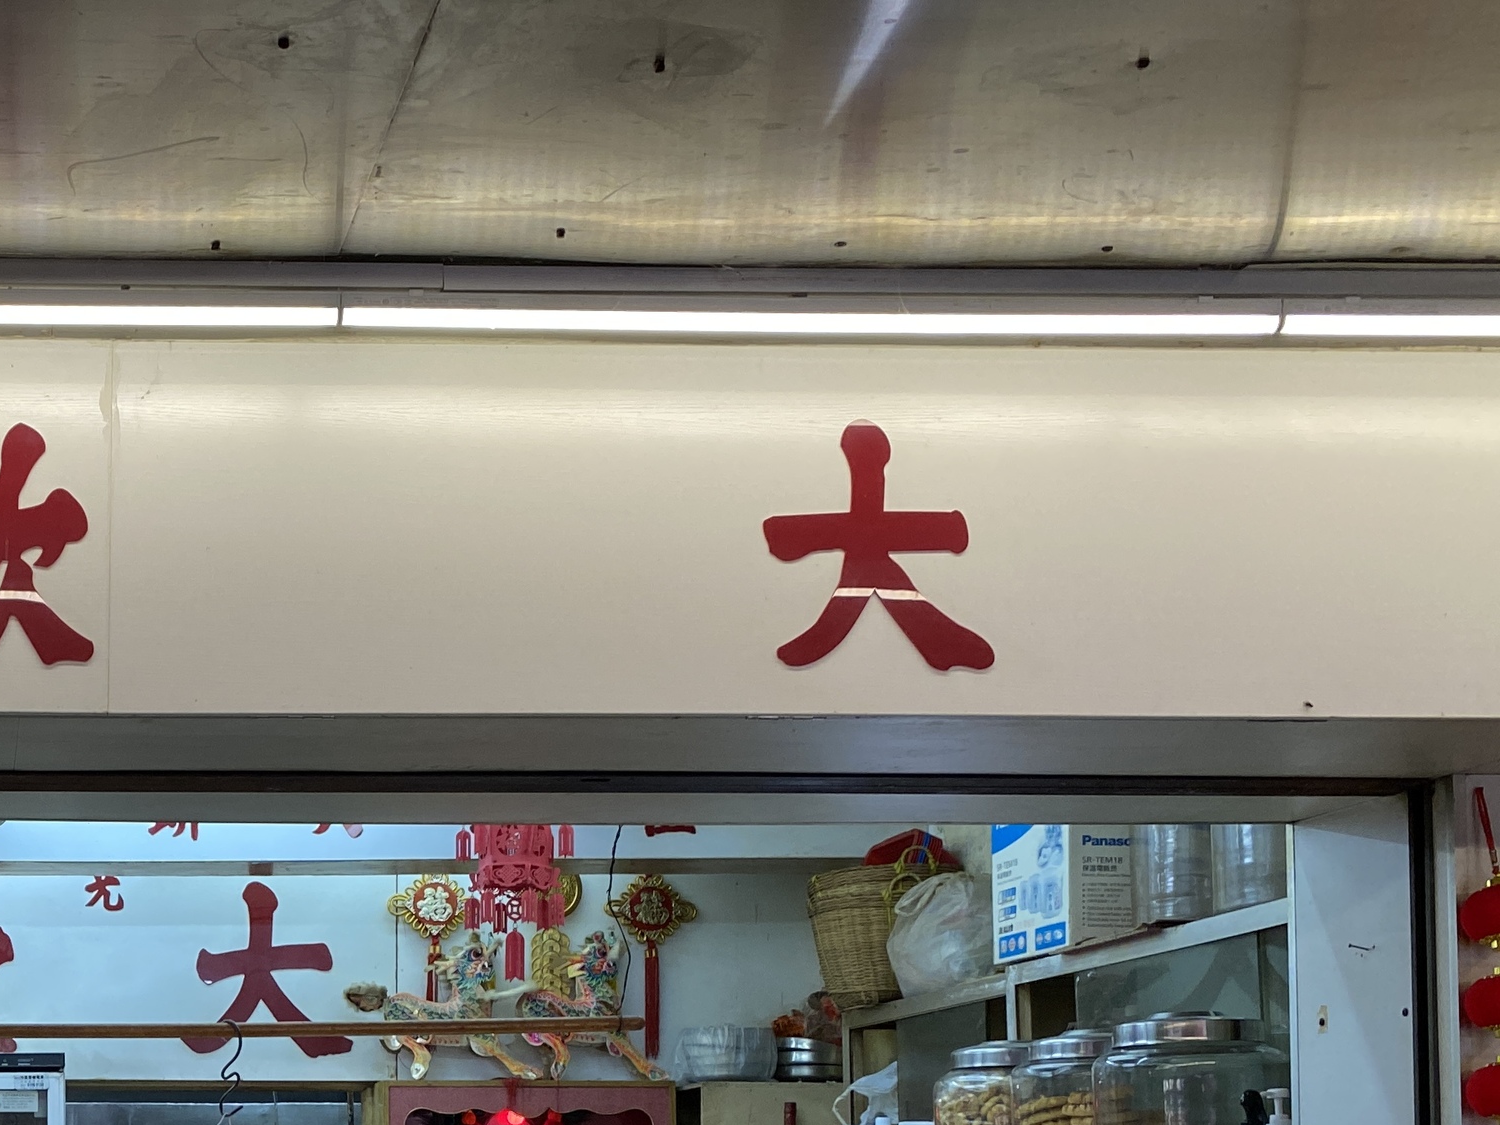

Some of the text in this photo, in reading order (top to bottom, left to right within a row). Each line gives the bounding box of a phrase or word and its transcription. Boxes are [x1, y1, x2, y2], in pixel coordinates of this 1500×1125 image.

[762, 418, 995, 671] 大
[1082, 835, 1131, 847] Panaso
[181, 881, 353, 1058] 大
